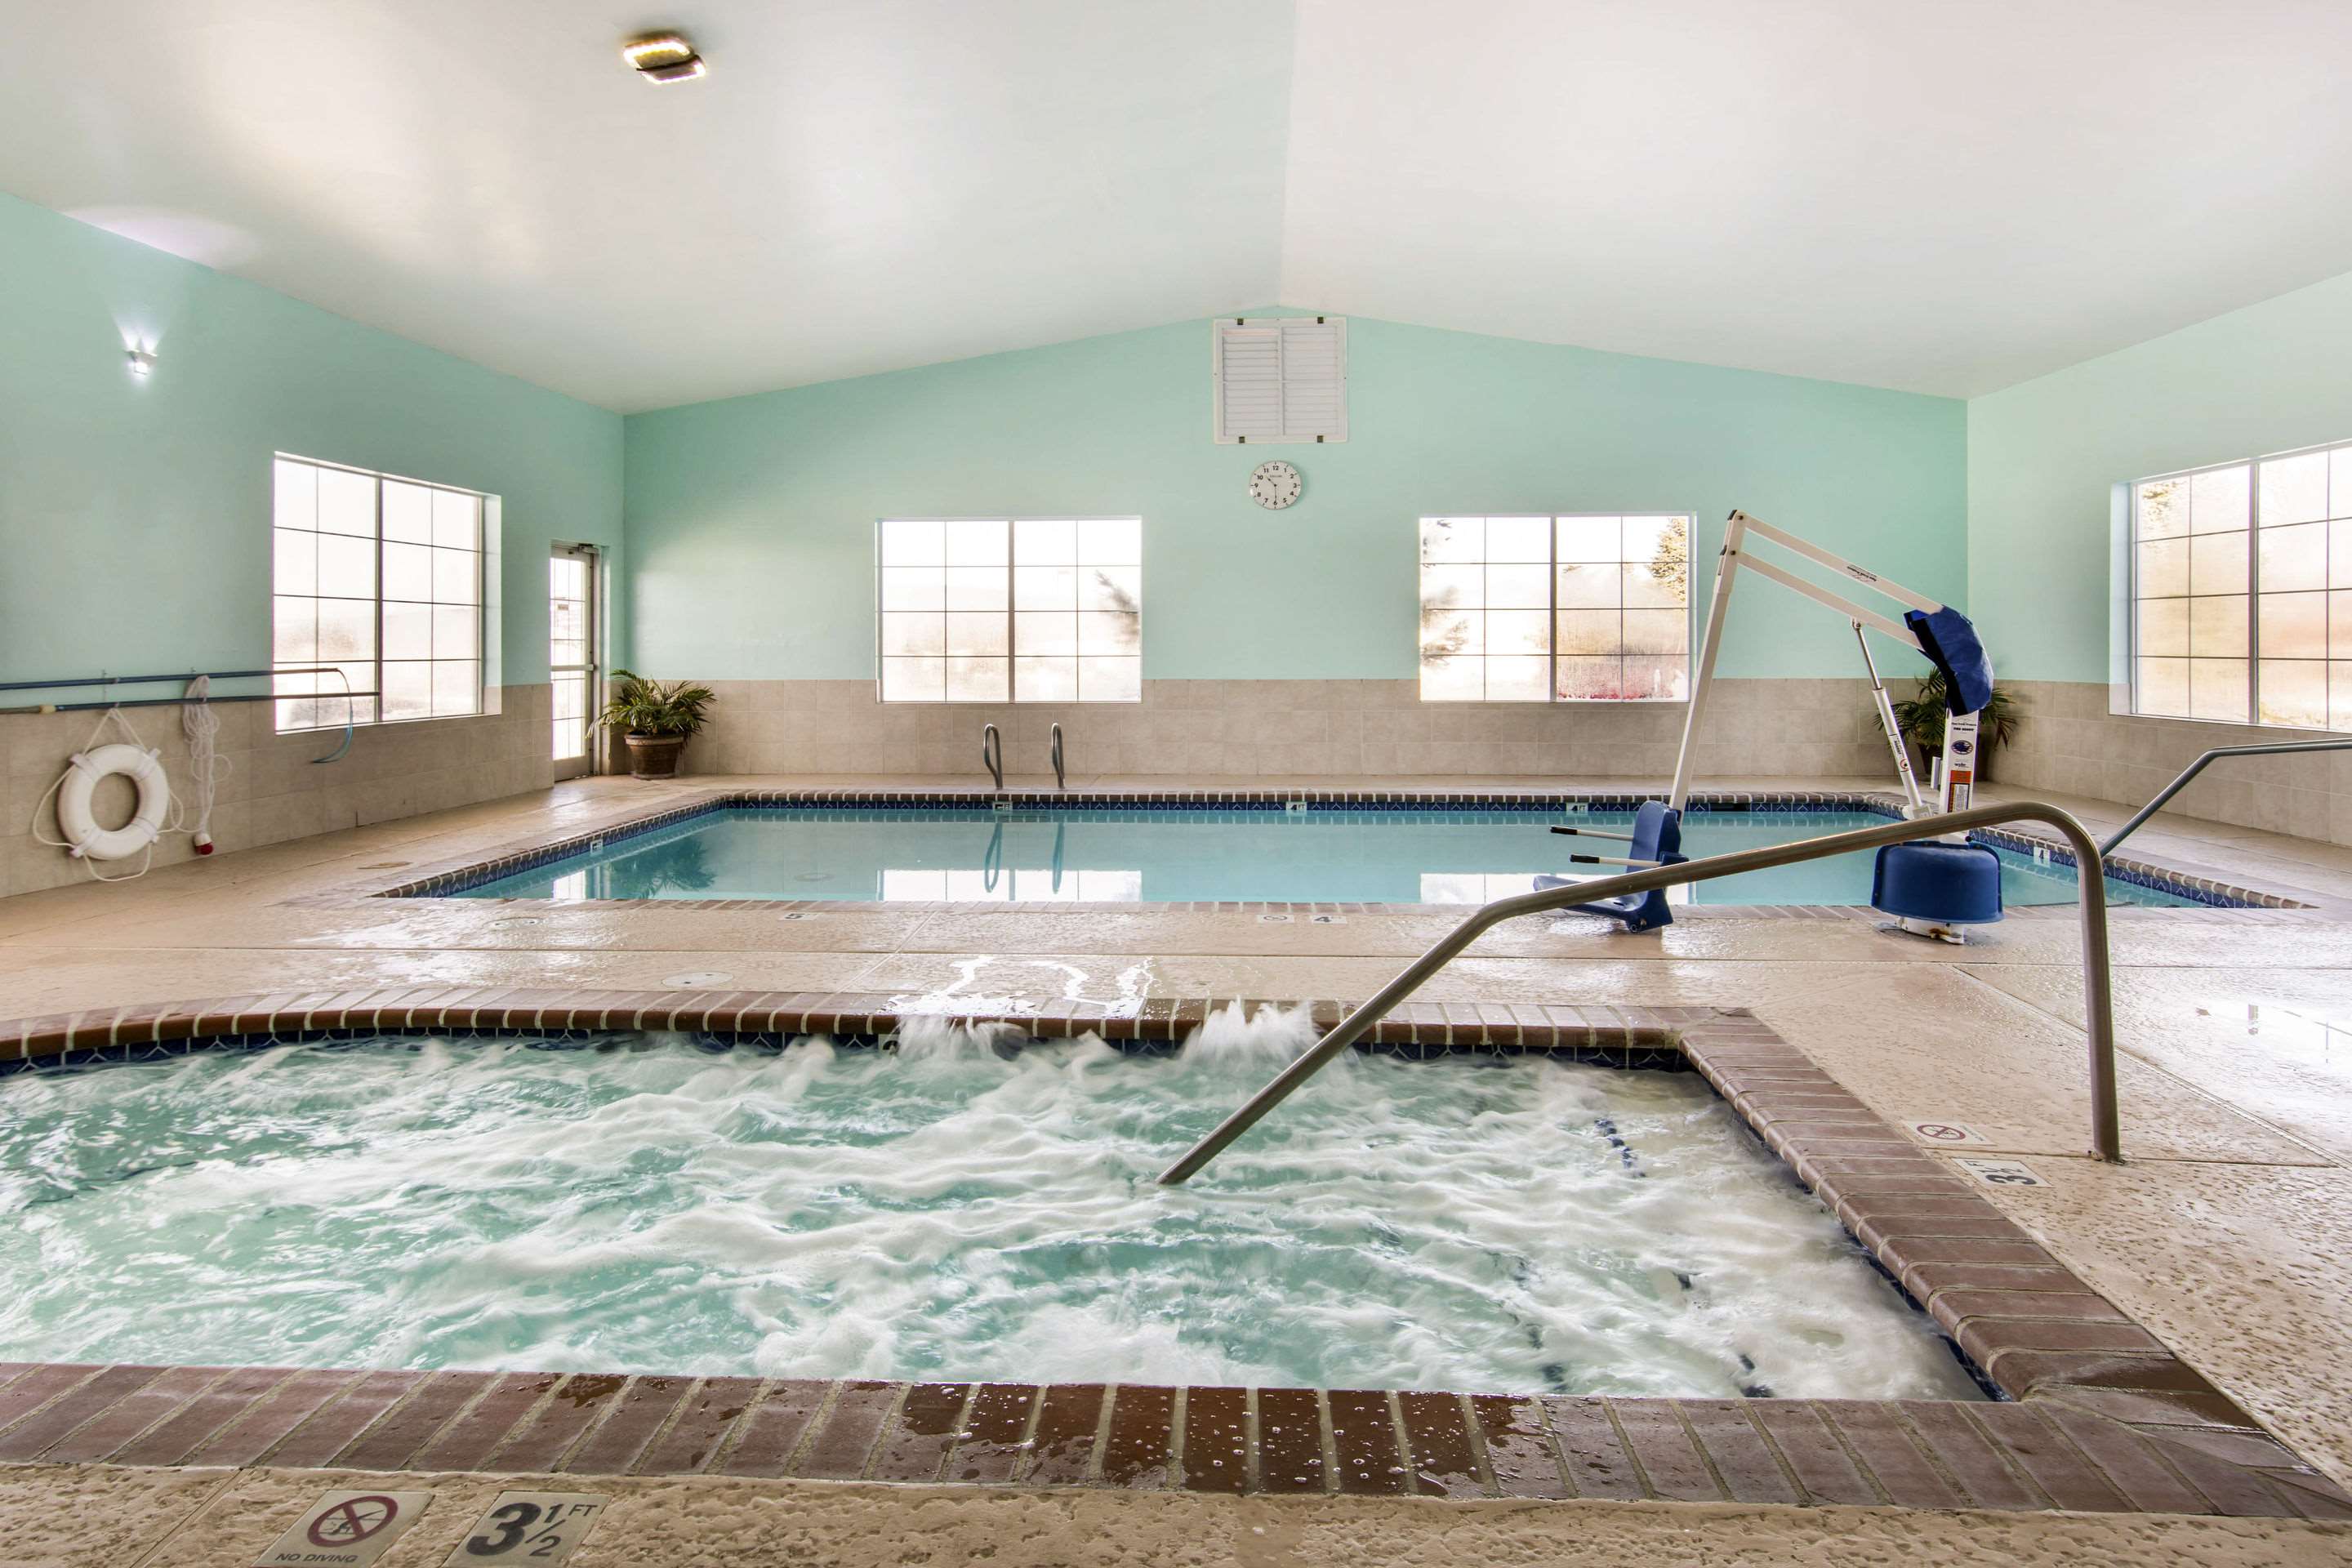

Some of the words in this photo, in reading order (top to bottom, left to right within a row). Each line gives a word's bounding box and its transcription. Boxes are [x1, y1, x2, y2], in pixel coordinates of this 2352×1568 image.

[1985, 1174, 2037, 1185] 3
[466, 1502, 542, 1556] 3
[568, 1504, 598, 1517] FT
[275, 1553, 301, 1561] NO
[302, 1554, 359, 1563] DIVING
